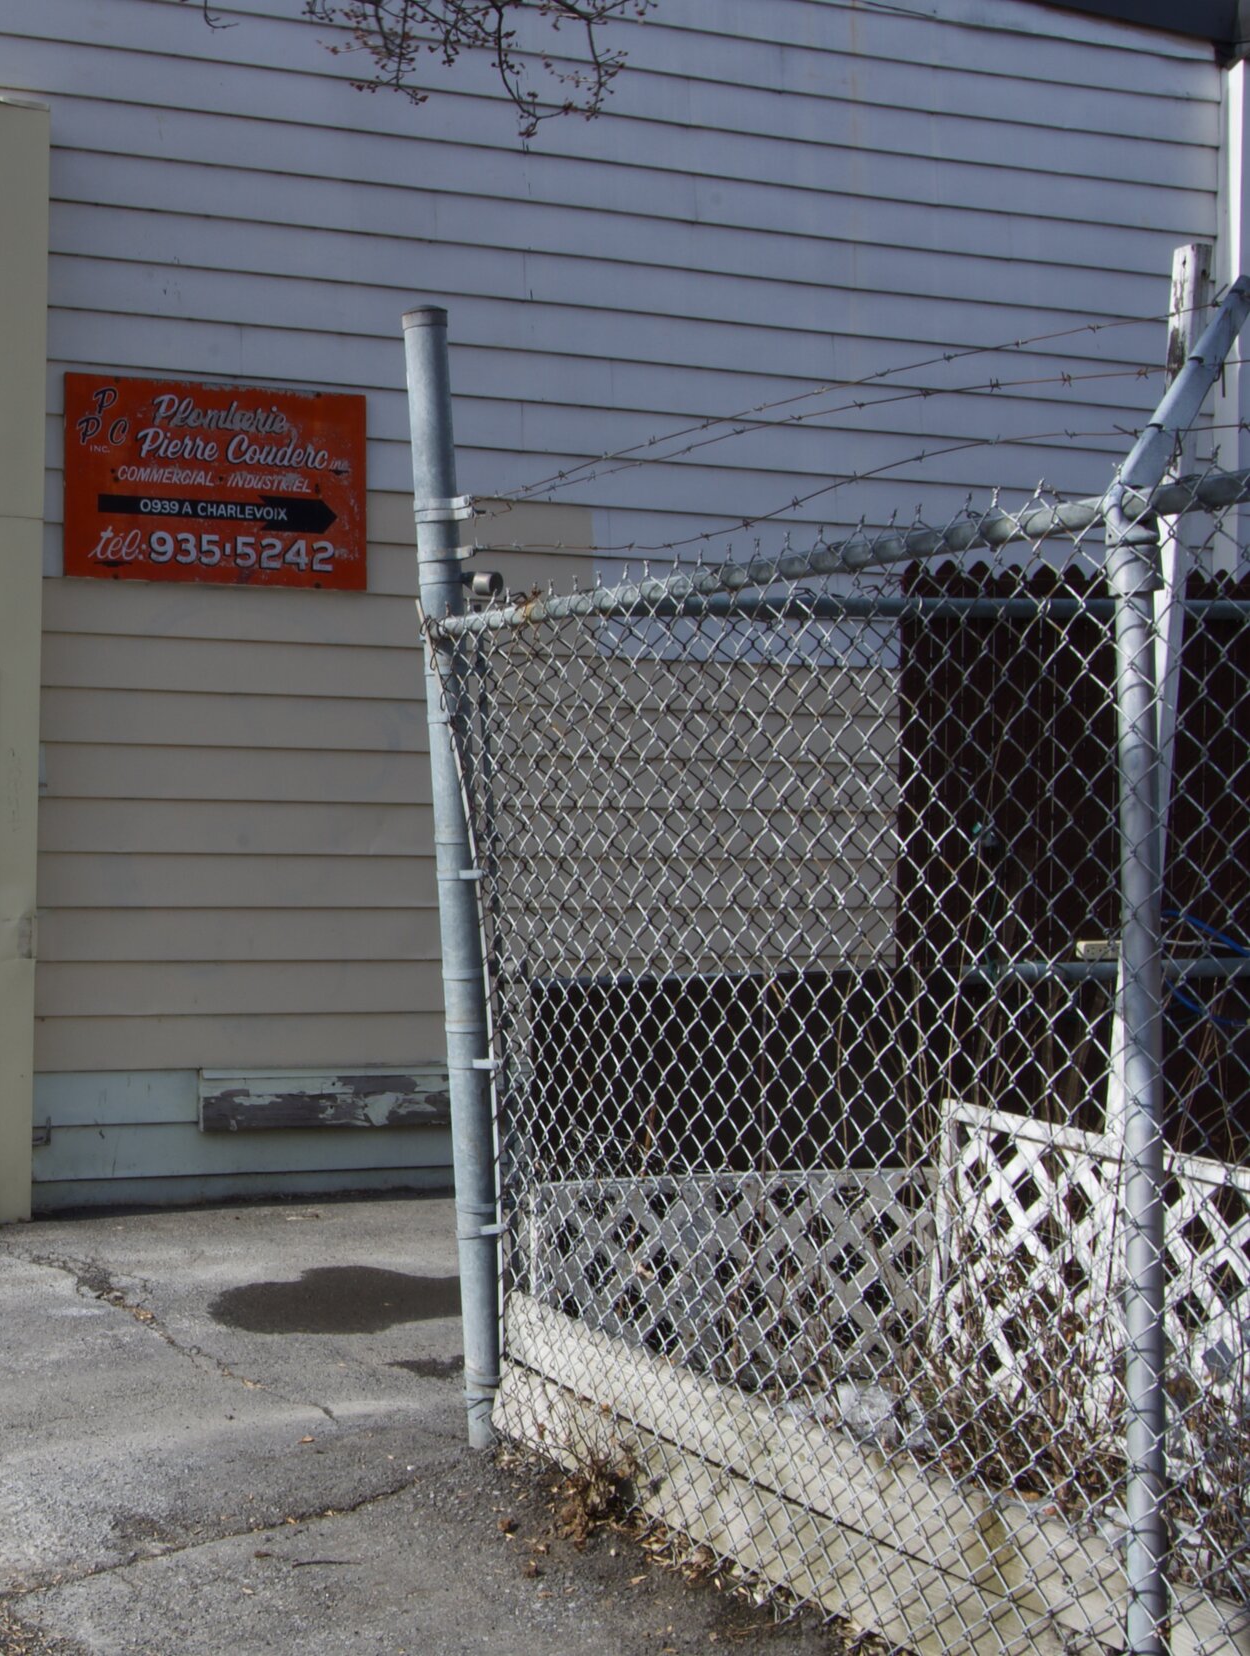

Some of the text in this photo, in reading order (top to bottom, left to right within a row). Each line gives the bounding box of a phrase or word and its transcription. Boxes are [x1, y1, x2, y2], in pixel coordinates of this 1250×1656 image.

[93, 386, 119, 417] P
[108, 418, 130, 446] C
[136, 427, 219, 461] Pierre
[226, 433, 328, 471] Couderc
[117, 464, 312, 493] COMMERCIAL INDUSTRIEL
[182, 502, 192, 515] A
[197, 502, 288, 521] CHARLEVOIX
